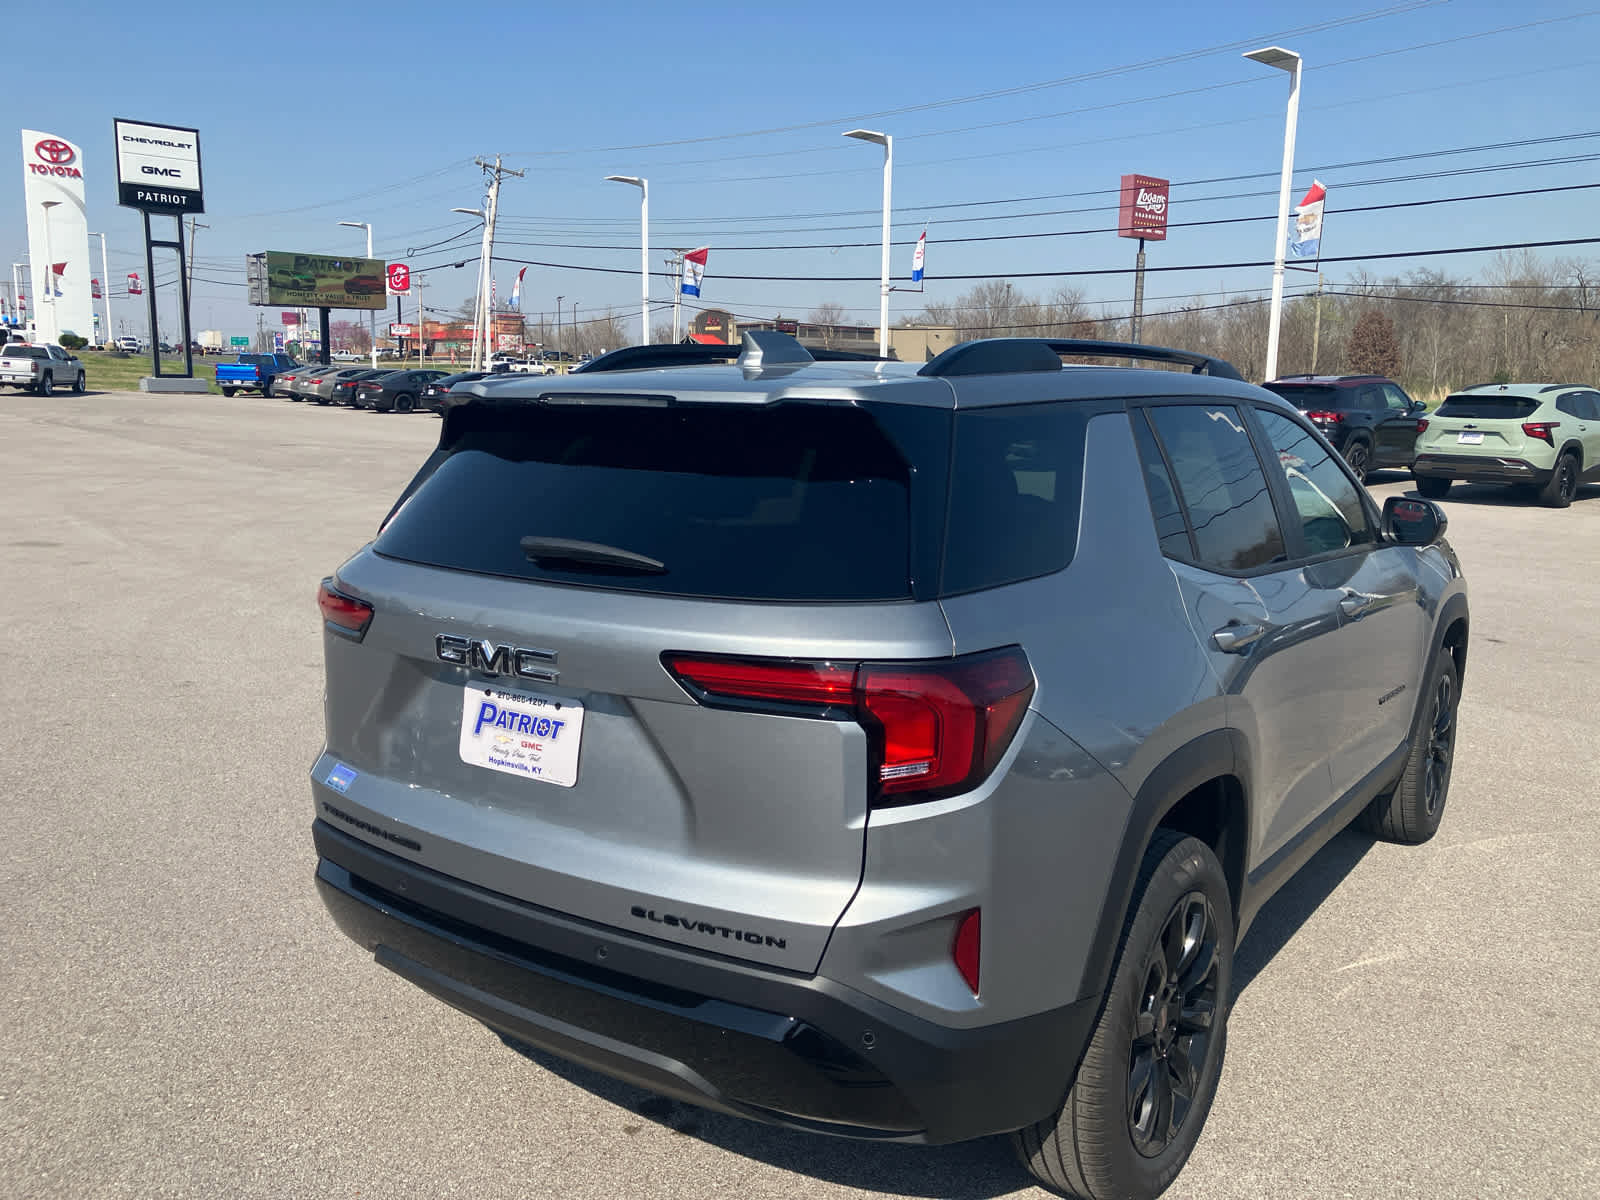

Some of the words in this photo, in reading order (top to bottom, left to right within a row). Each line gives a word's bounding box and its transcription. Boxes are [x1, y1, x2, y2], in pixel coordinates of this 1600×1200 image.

[122, 135, 193, 150] CHEVROLET
[28, 162, 82, 179] TOYOTA
[141, 165, 182, 178] GMC
[137, 191, 188, 205] PATRIOT
[294, 255, 365, 274] PATRIOT
[434, 633, 561, 684] GMC
[474, 701, 565, 740] PATRIOT
[521, 741, 543, 751] GMC
[531, 762, 542, 775] KY
[630, 905, 787, 950] ELEVATION
